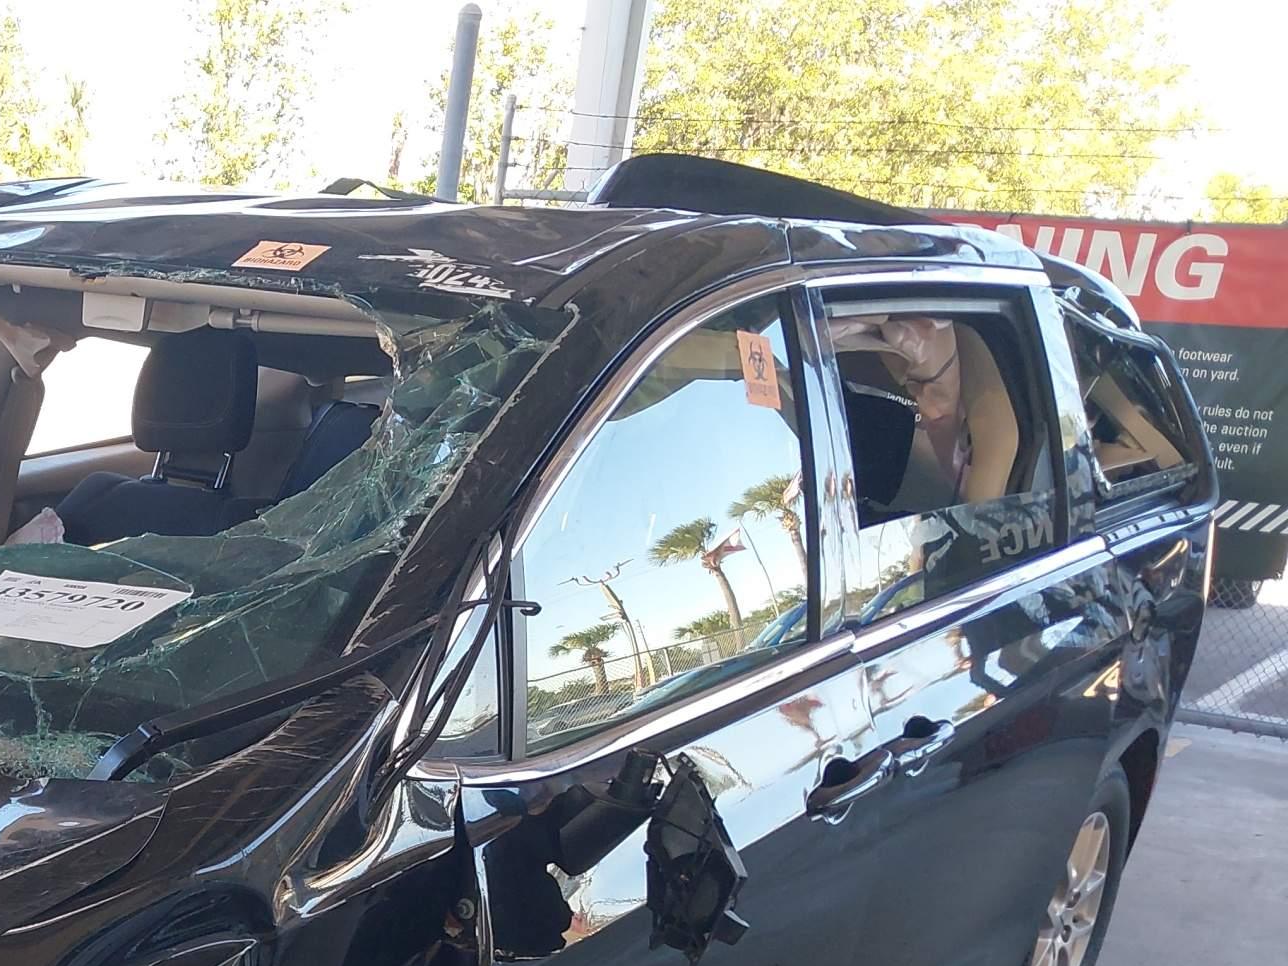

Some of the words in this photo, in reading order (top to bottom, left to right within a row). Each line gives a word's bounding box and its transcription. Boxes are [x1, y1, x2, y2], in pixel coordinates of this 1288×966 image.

[1178, 347, 1233, 364] footwear
[1192, 368, 1207, 378] on
[1211, 368, 1240, 382] yard.
[1202, 404, 1232, 417] rules
[1234, 406, 1250, 419] do
[1253, 410, 1274, 421] not
[1203, 421, 1217, 433] he
[1220, 424, 1268, 438] auction
[1218, 443, 1249, 454] even
[1252, 442, 1262, 455] if
